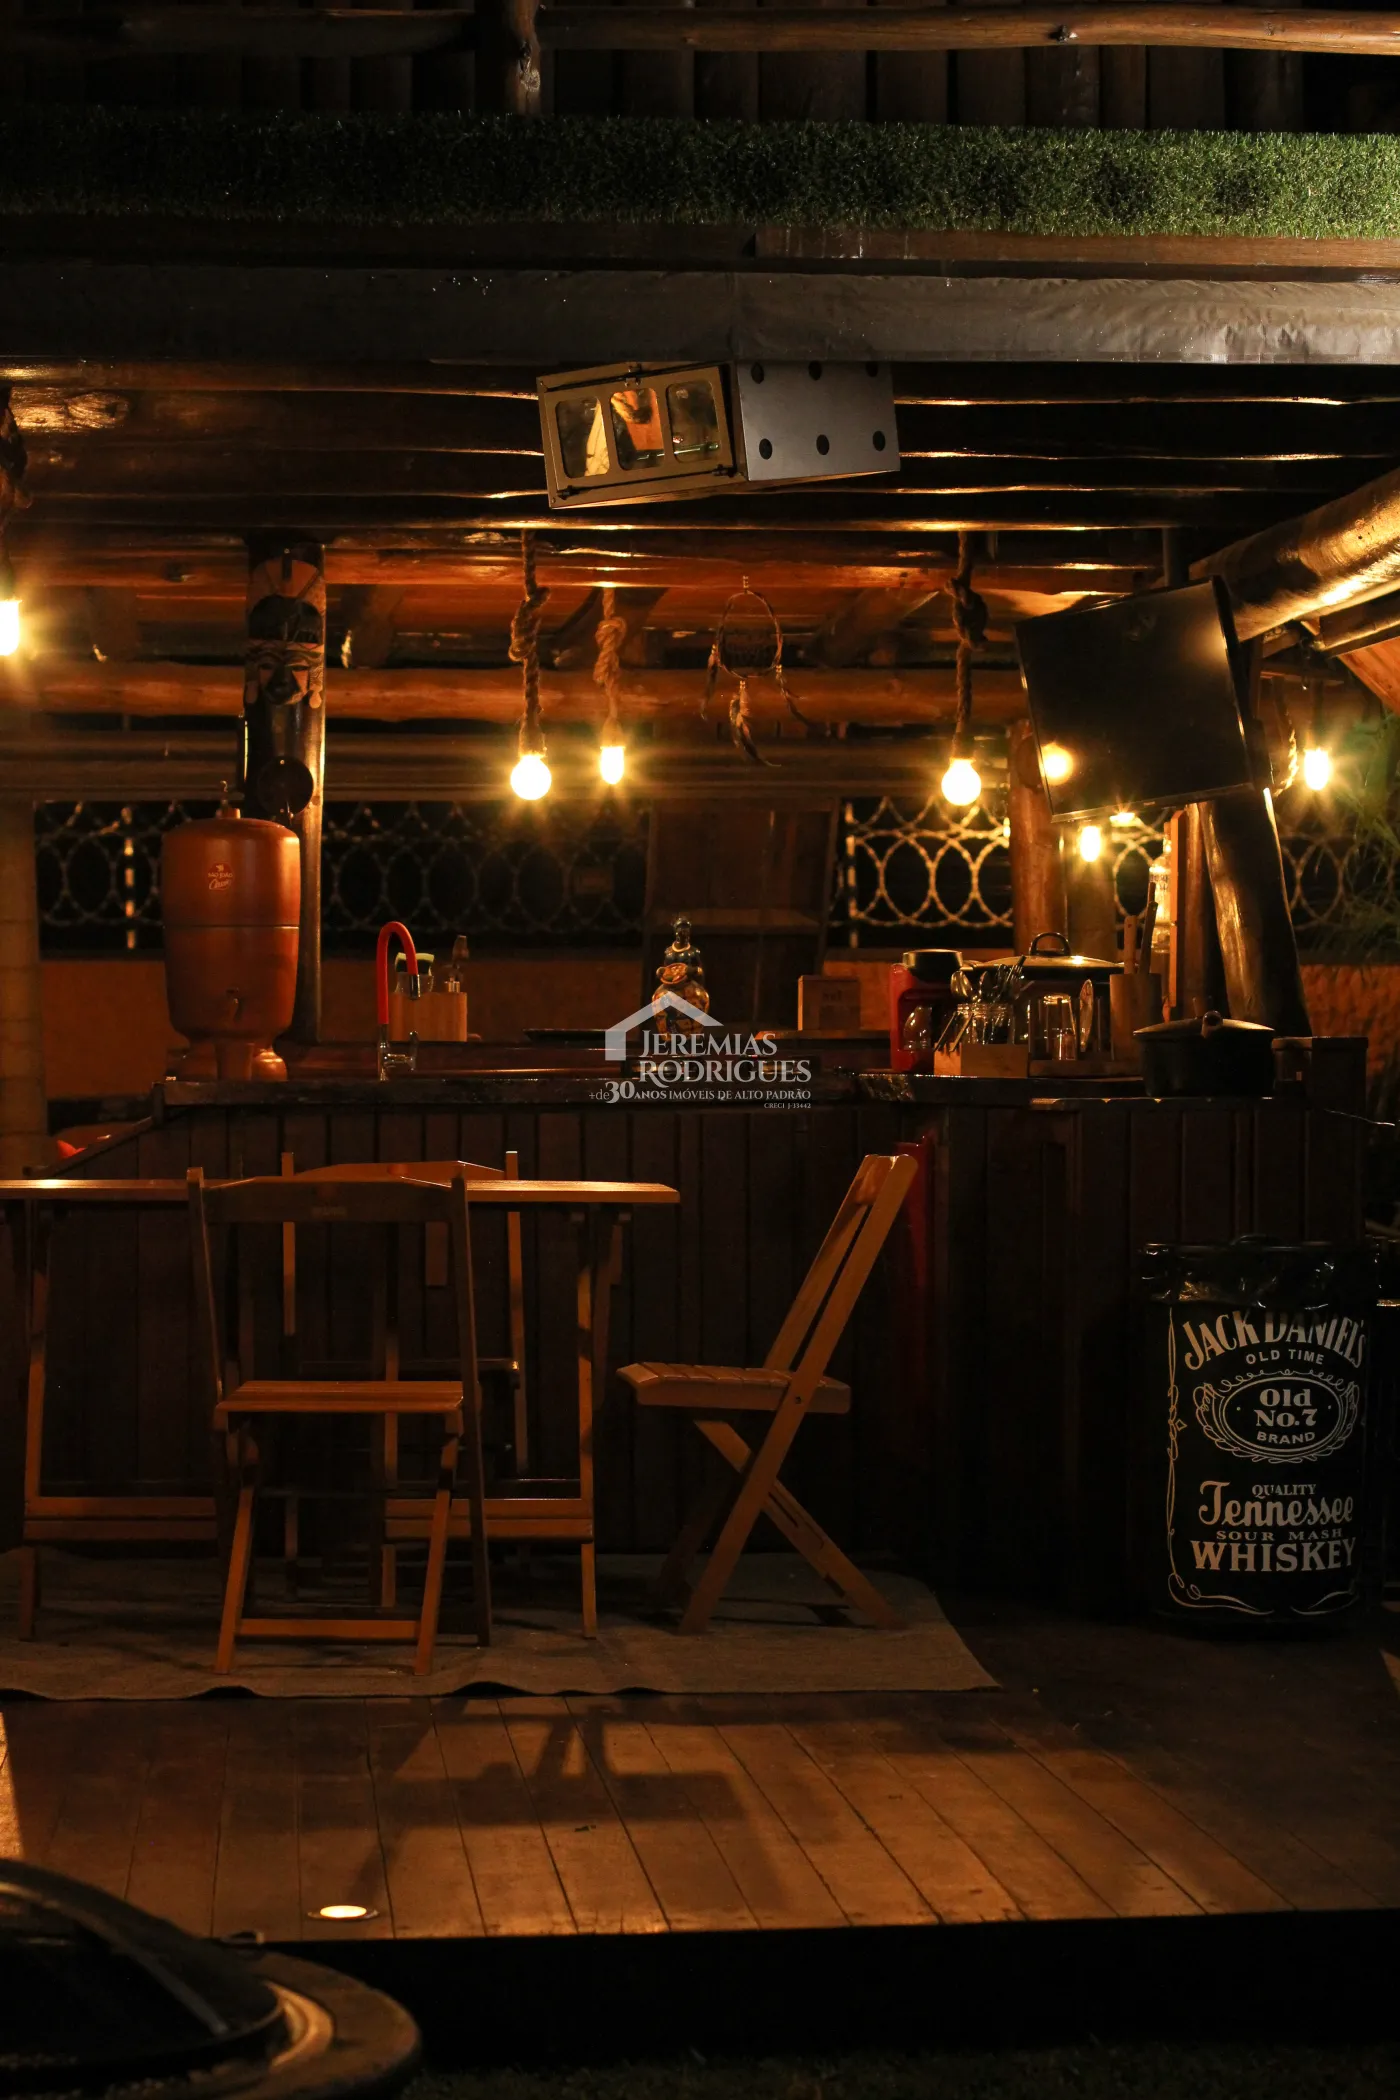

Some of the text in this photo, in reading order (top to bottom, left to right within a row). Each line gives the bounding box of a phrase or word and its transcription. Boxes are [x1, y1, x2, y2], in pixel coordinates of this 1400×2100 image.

[1182, 1309, 1260, 1371] JACK
[1245, 1348, 1325, 1365] OLD TIME
[1259, 1388, 1312, 1407] Old
[1256, 1431, 1316, 1445] BRAND
[1252, 1484, 1317, 1499] QUALITY
[1198, 1480, 1354, 1527] Tennessee
[1216, 1528, 1344, 1541] SOUR MASH
[1190, 1537, 1357, 1572] WHISKEY
